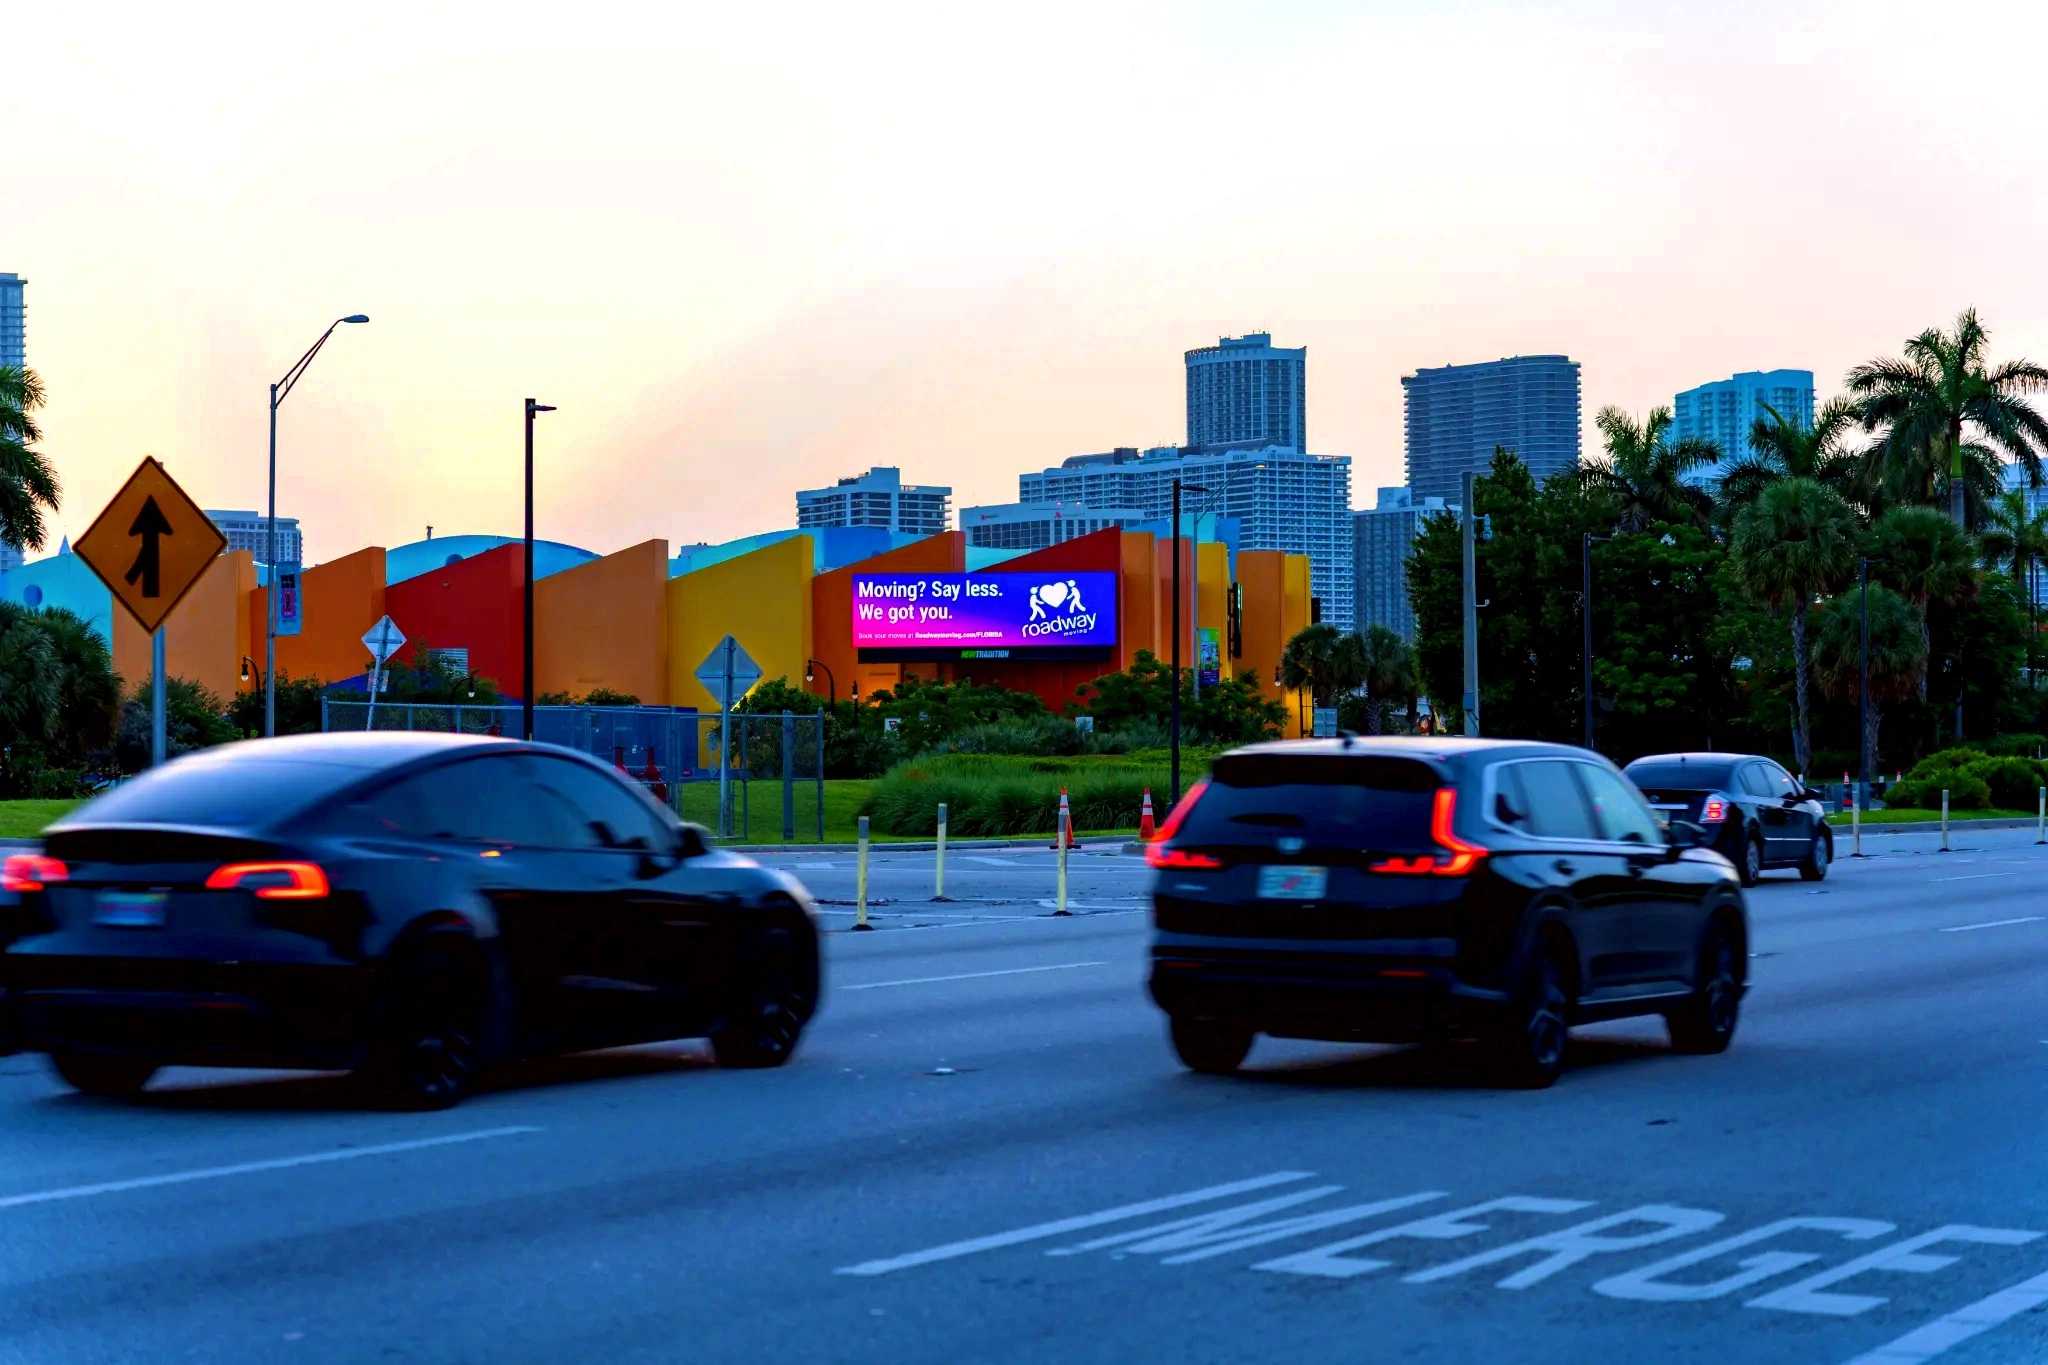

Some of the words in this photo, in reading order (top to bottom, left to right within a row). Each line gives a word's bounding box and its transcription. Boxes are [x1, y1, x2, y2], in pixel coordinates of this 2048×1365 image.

[858, 581, 926, 601] Moving?
[932, 581, 960, 601] Say
[966, 580, 1003, 597] less.
[859, 604, 883, 620] We
[888, 605, 914, 624] got
[919, 606, 952, 623] you.
[1022, 613, 1096, 637] roadway
[1043, 1185, 2046, 1315] MERGE
